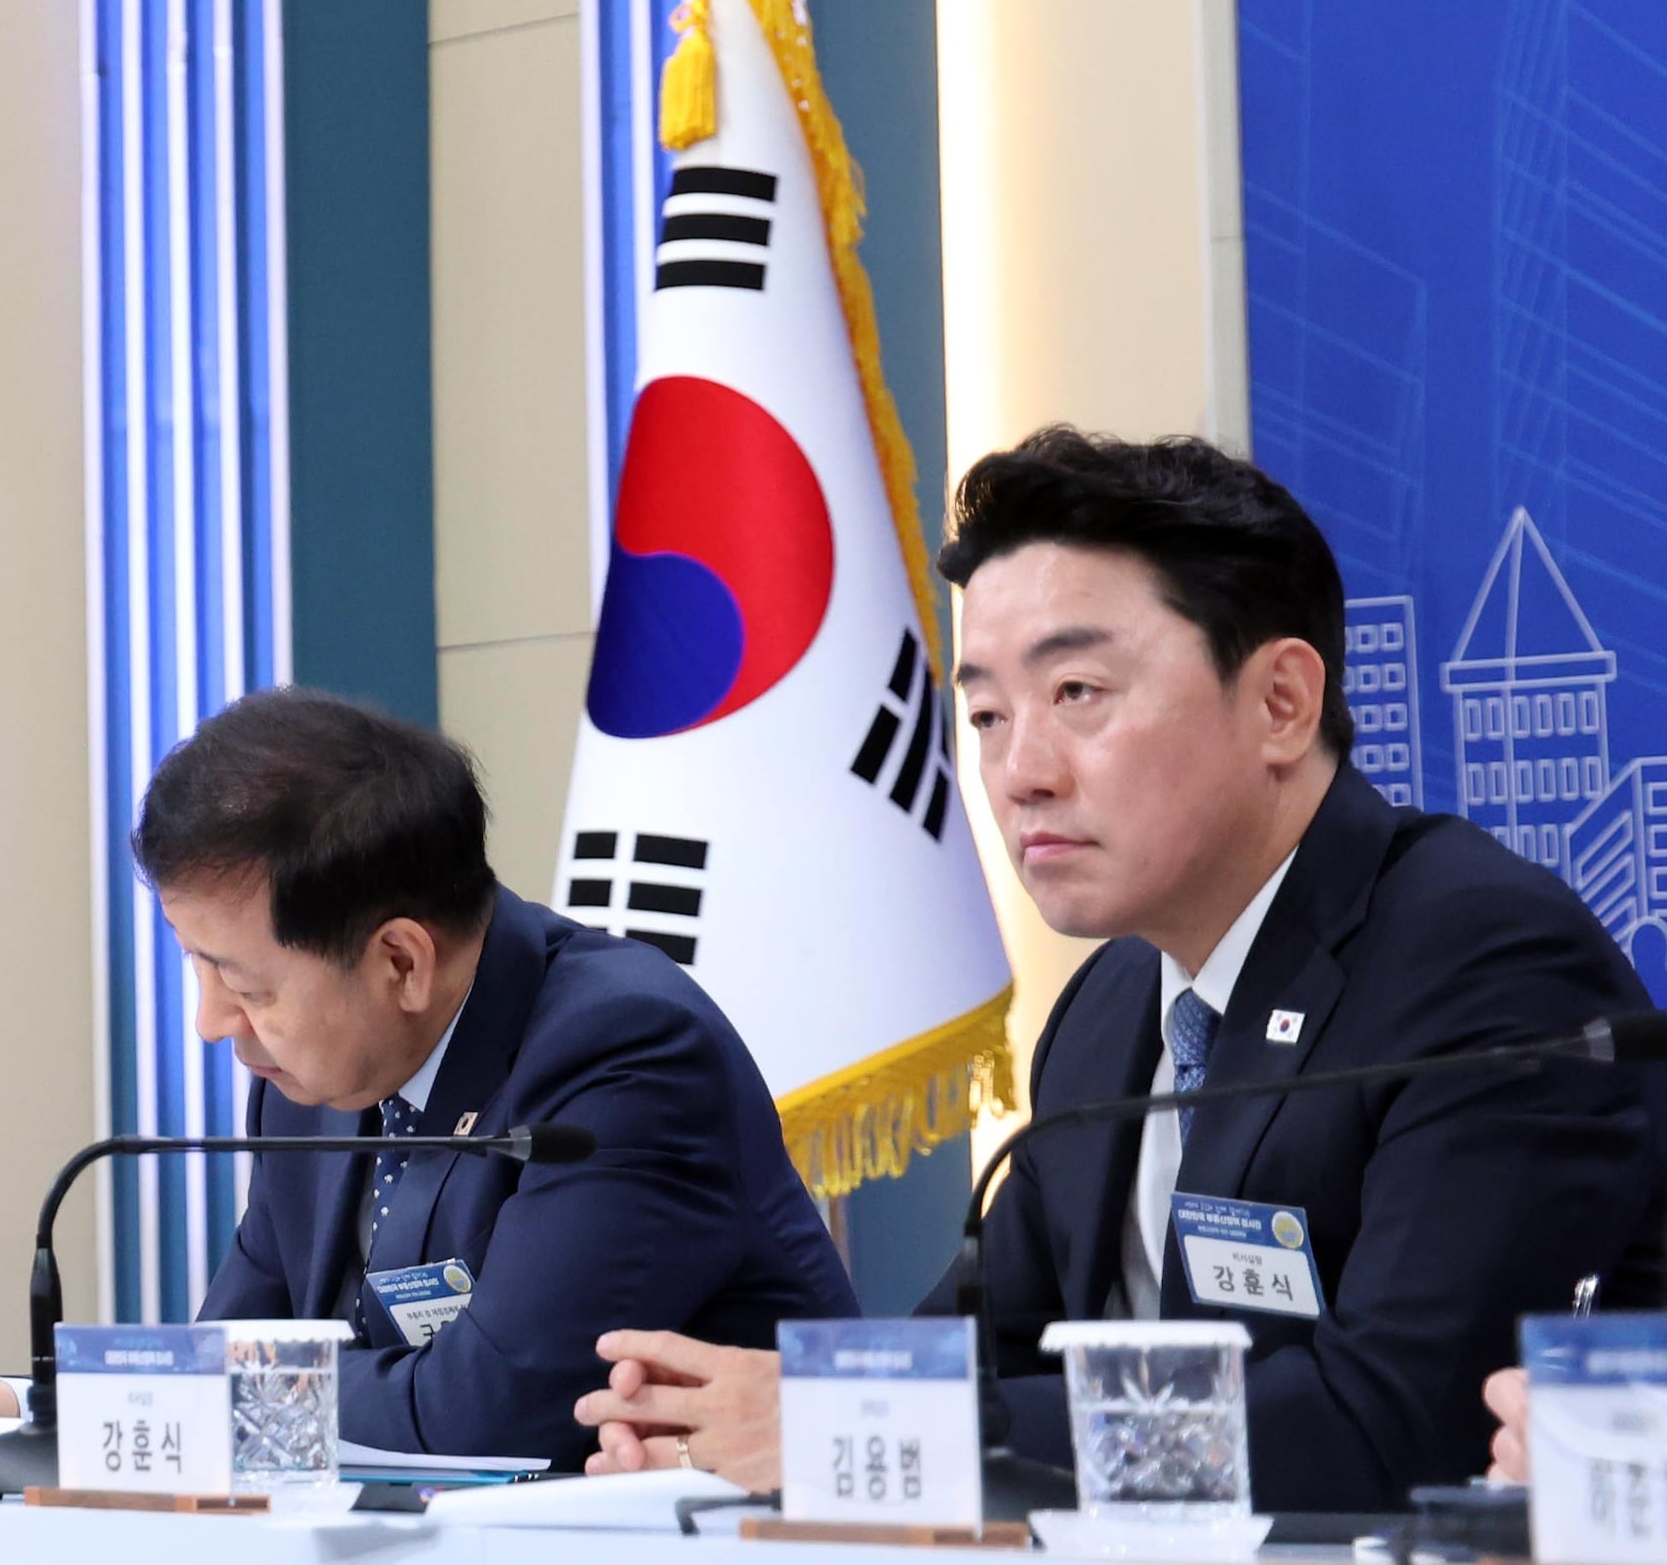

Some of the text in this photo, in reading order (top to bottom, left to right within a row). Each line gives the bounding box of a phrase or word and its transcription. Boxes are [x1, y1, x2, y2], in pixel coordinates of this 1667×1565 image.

[1212, 1265, 1293, 1302] 강훈식
[102, 1421, 181, 1474] 강훈식
[832, 1434, 922, 1501] 김용범
